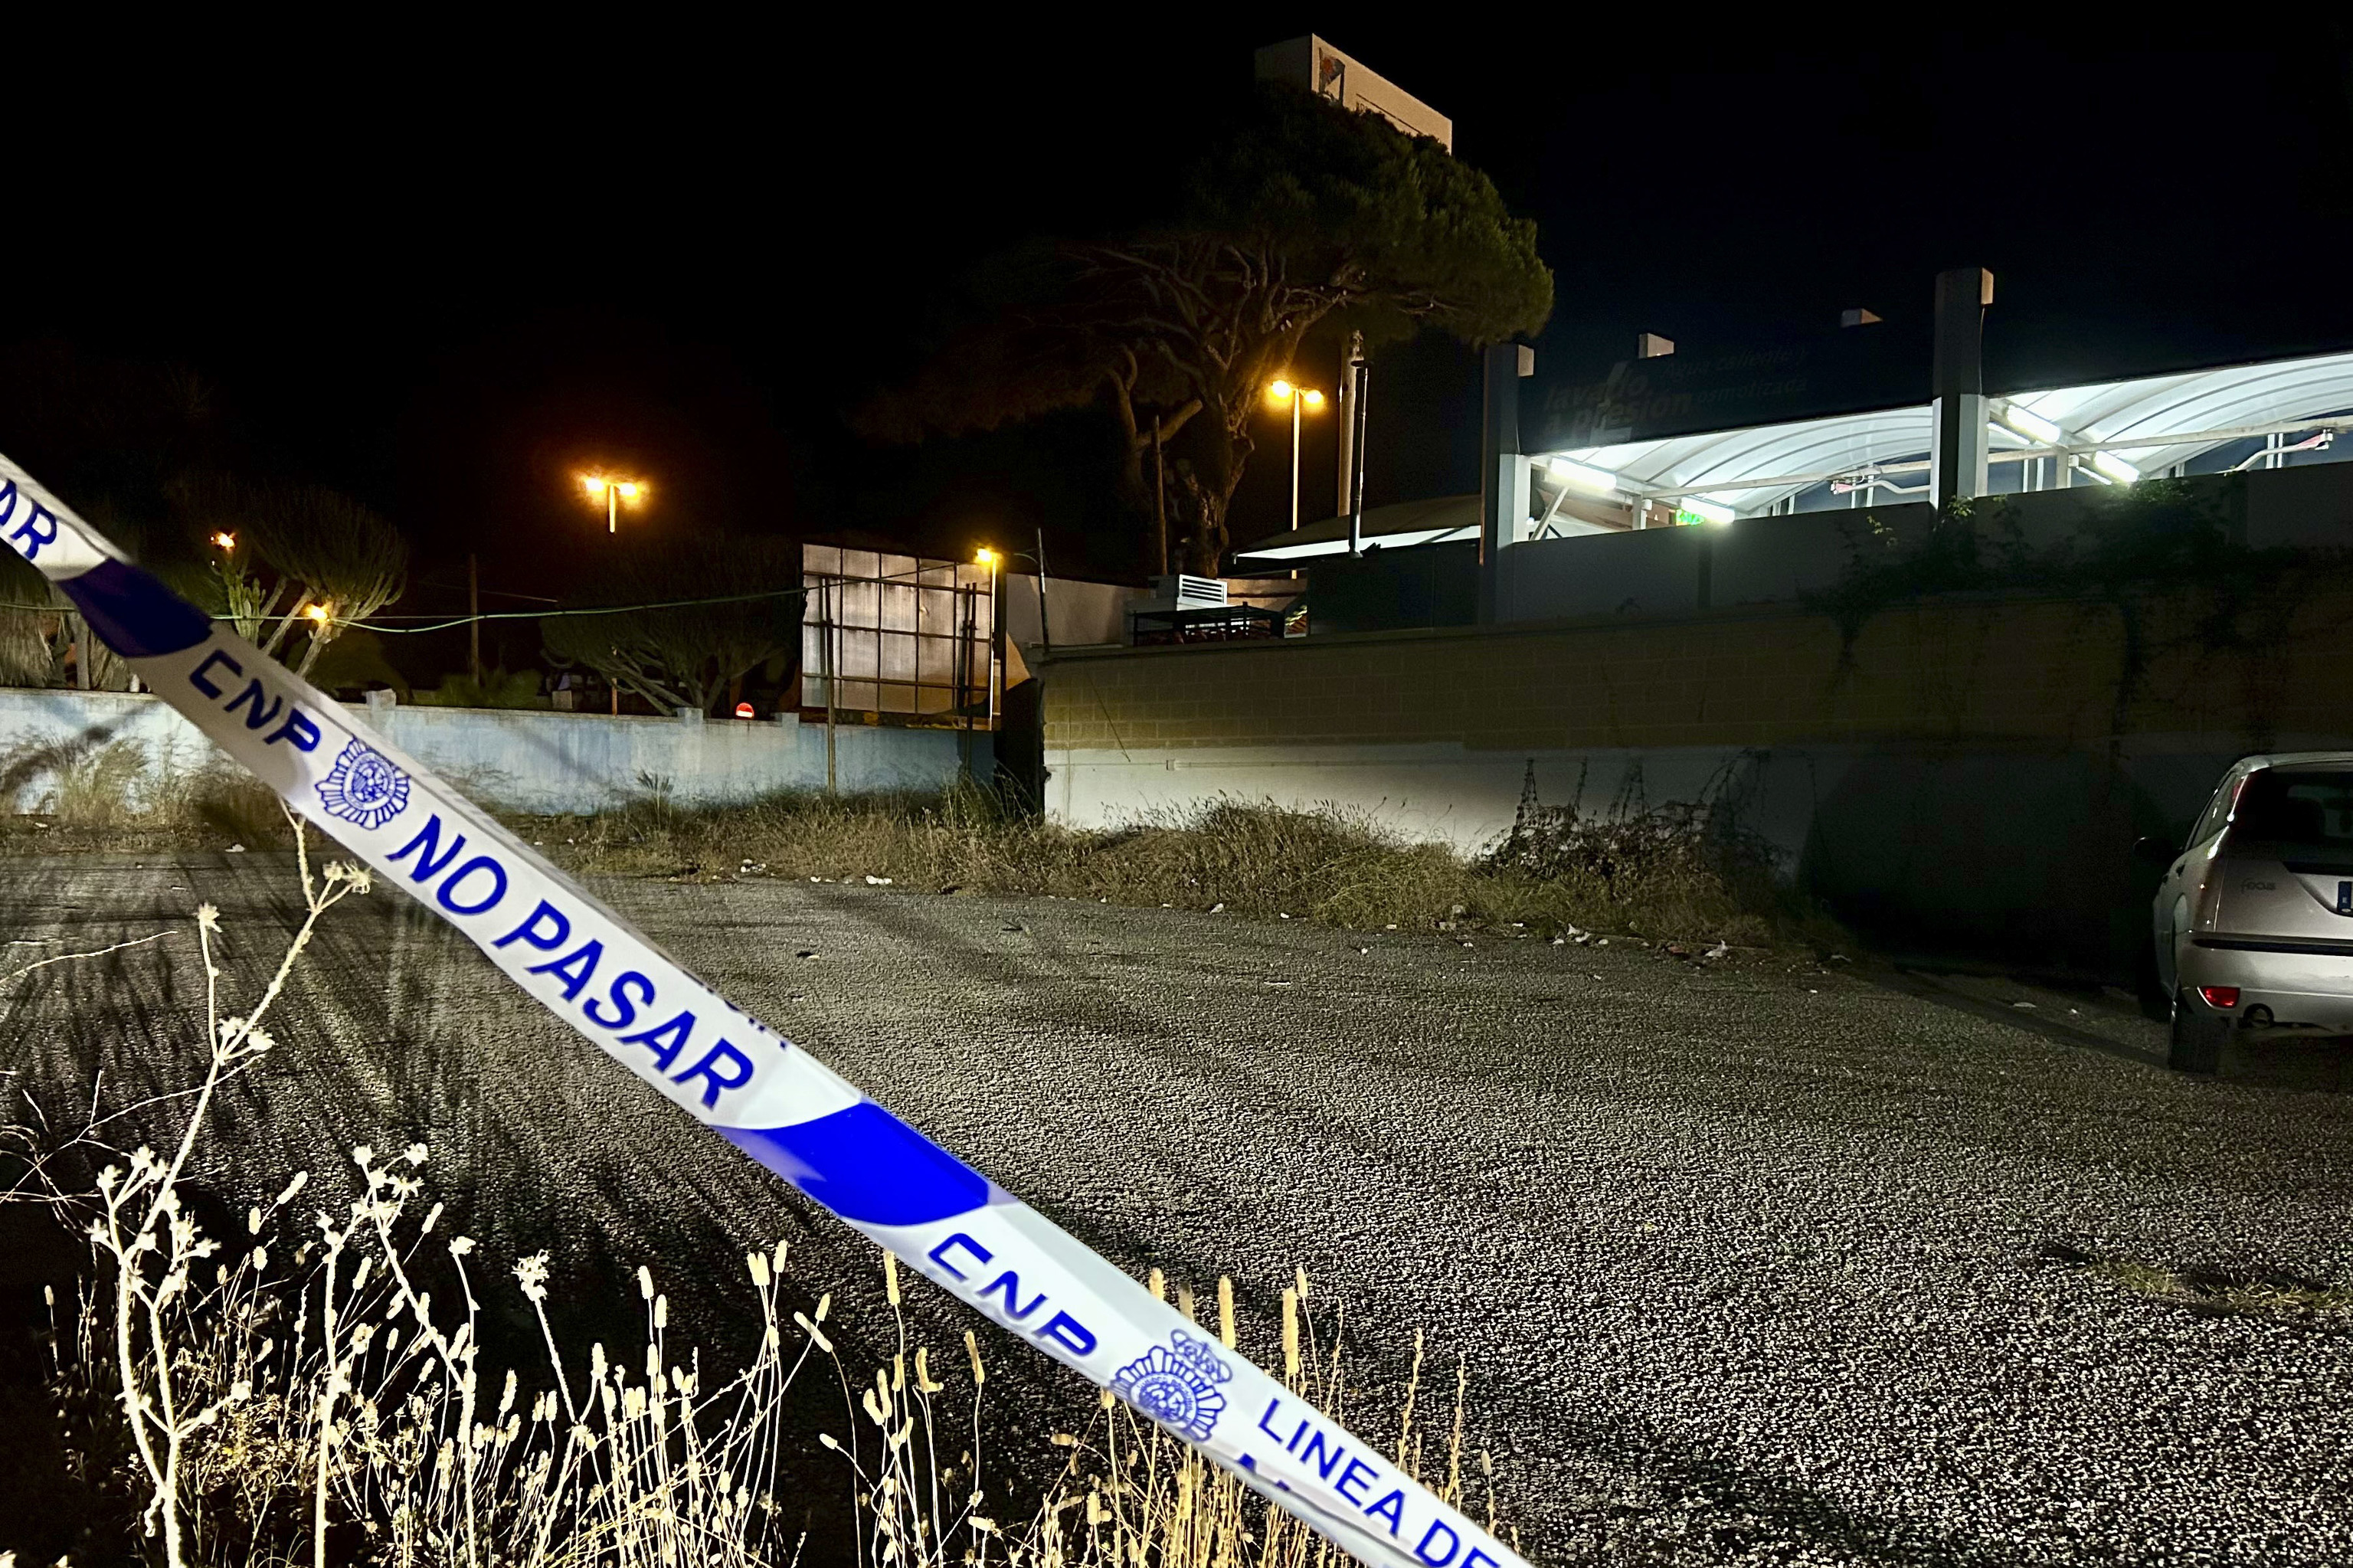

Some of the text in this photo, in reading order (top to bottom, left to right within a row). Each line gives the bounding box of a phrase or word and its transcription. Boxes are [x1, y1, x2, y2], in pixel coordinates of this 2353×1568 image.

[189, 649, 321, 752] CNP
[385, 813, 508, 915] NO
[491, 898, 755, 1111] PASAR
[927, 1232, 1098, 1357] CNP
[1258, 1397, 1406, 1540] LINEA
